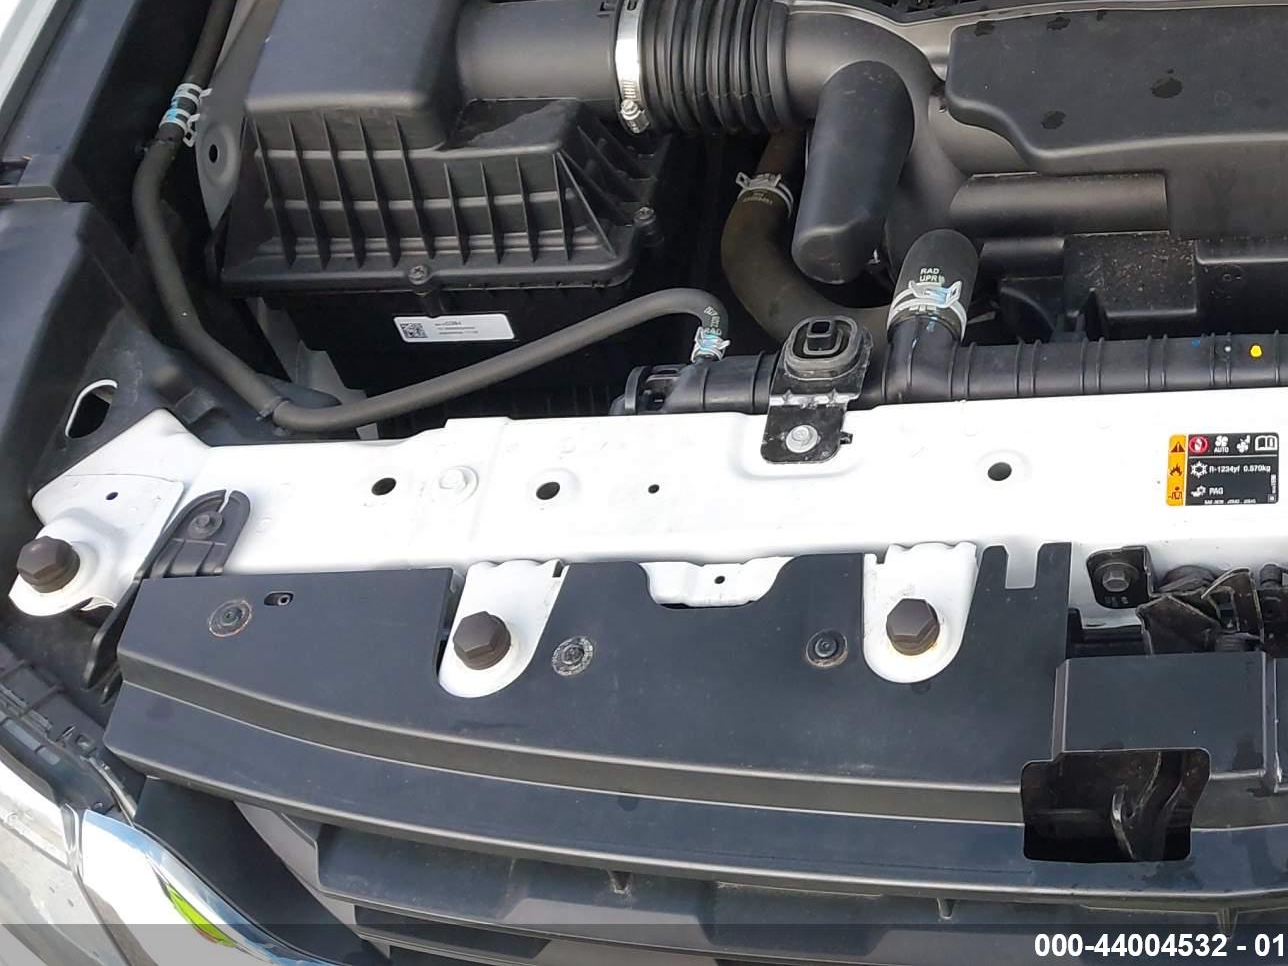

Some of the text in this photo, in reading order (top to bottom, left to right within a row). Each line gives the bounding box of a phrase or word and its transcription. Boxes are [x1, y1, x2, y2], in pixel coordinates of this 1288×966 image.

[920, 267, 940, 275] RAD
[919, 274, 938, 282] UPR
[1213, 445, 1229, 453] AUTO
[1209, 487, 1224, 496] PAG
